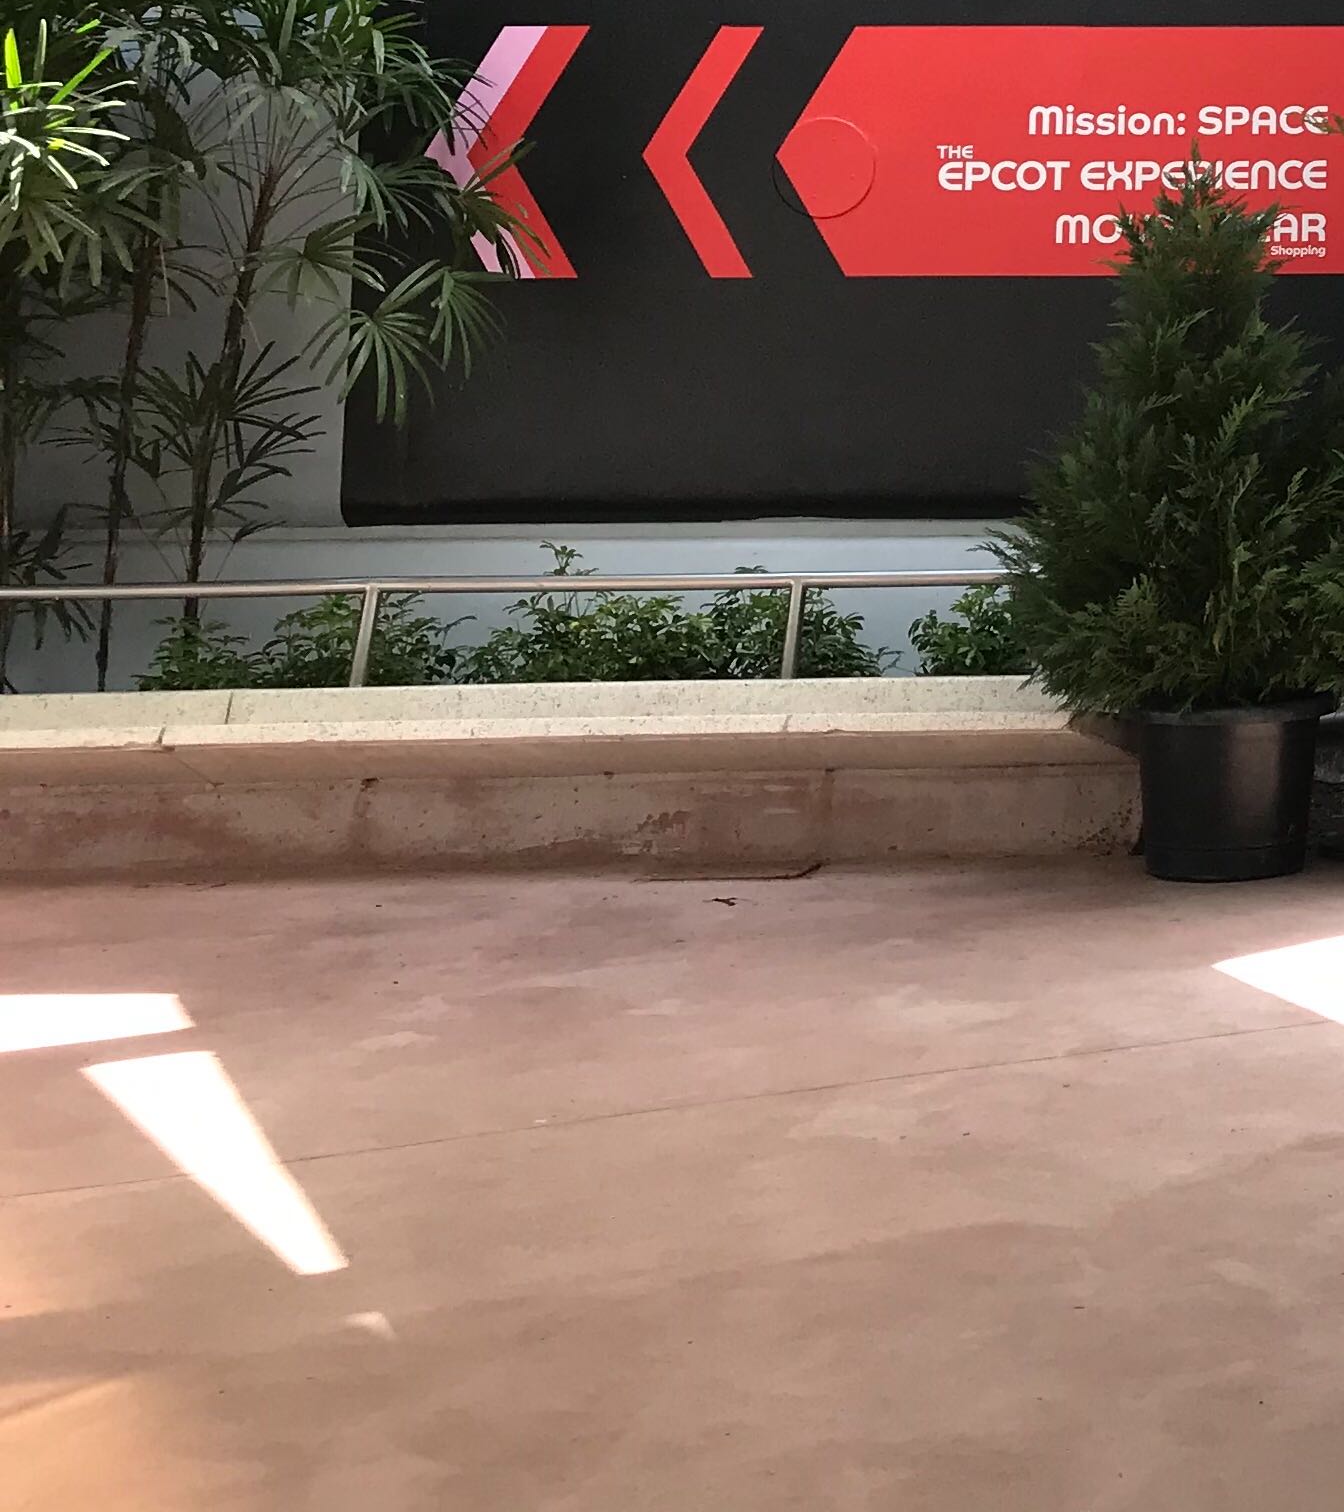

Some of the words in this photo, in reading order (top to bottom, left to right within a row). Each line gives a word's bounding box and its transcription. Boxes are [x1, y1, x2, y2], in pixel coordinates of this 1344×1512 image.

[1028, 104, 1187, 136] Mission:
[1197, 105, 1329, 135] SPACE
[936, 144, 974, 160] THE
[938, 160, 1071, 191] EPCOT
[1270, 244, 1327, 258] Shopping
